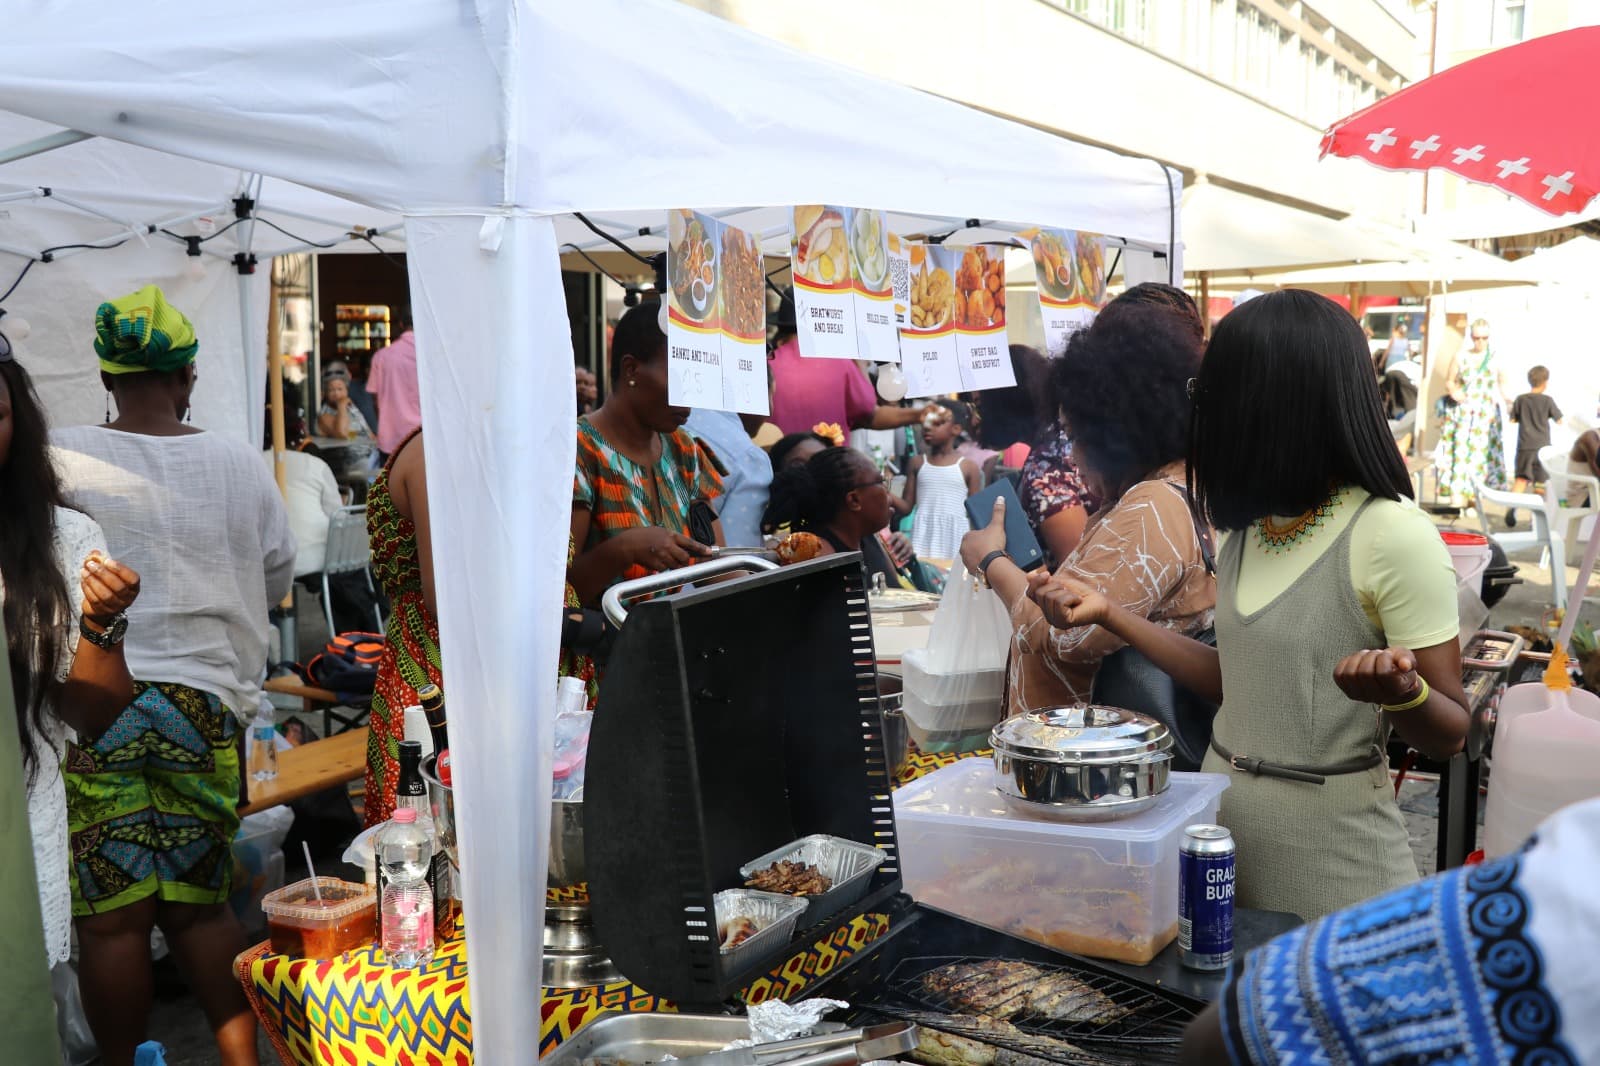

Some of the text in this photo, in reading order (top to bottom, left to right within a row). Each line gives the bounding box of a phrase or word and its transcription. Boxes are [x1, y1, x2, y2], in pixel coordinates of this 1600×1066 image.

[814, 321, 844, 334] AND BREAD
[672, 346, 690, 360] BANKU
[691, 349, 702, 362] AND
